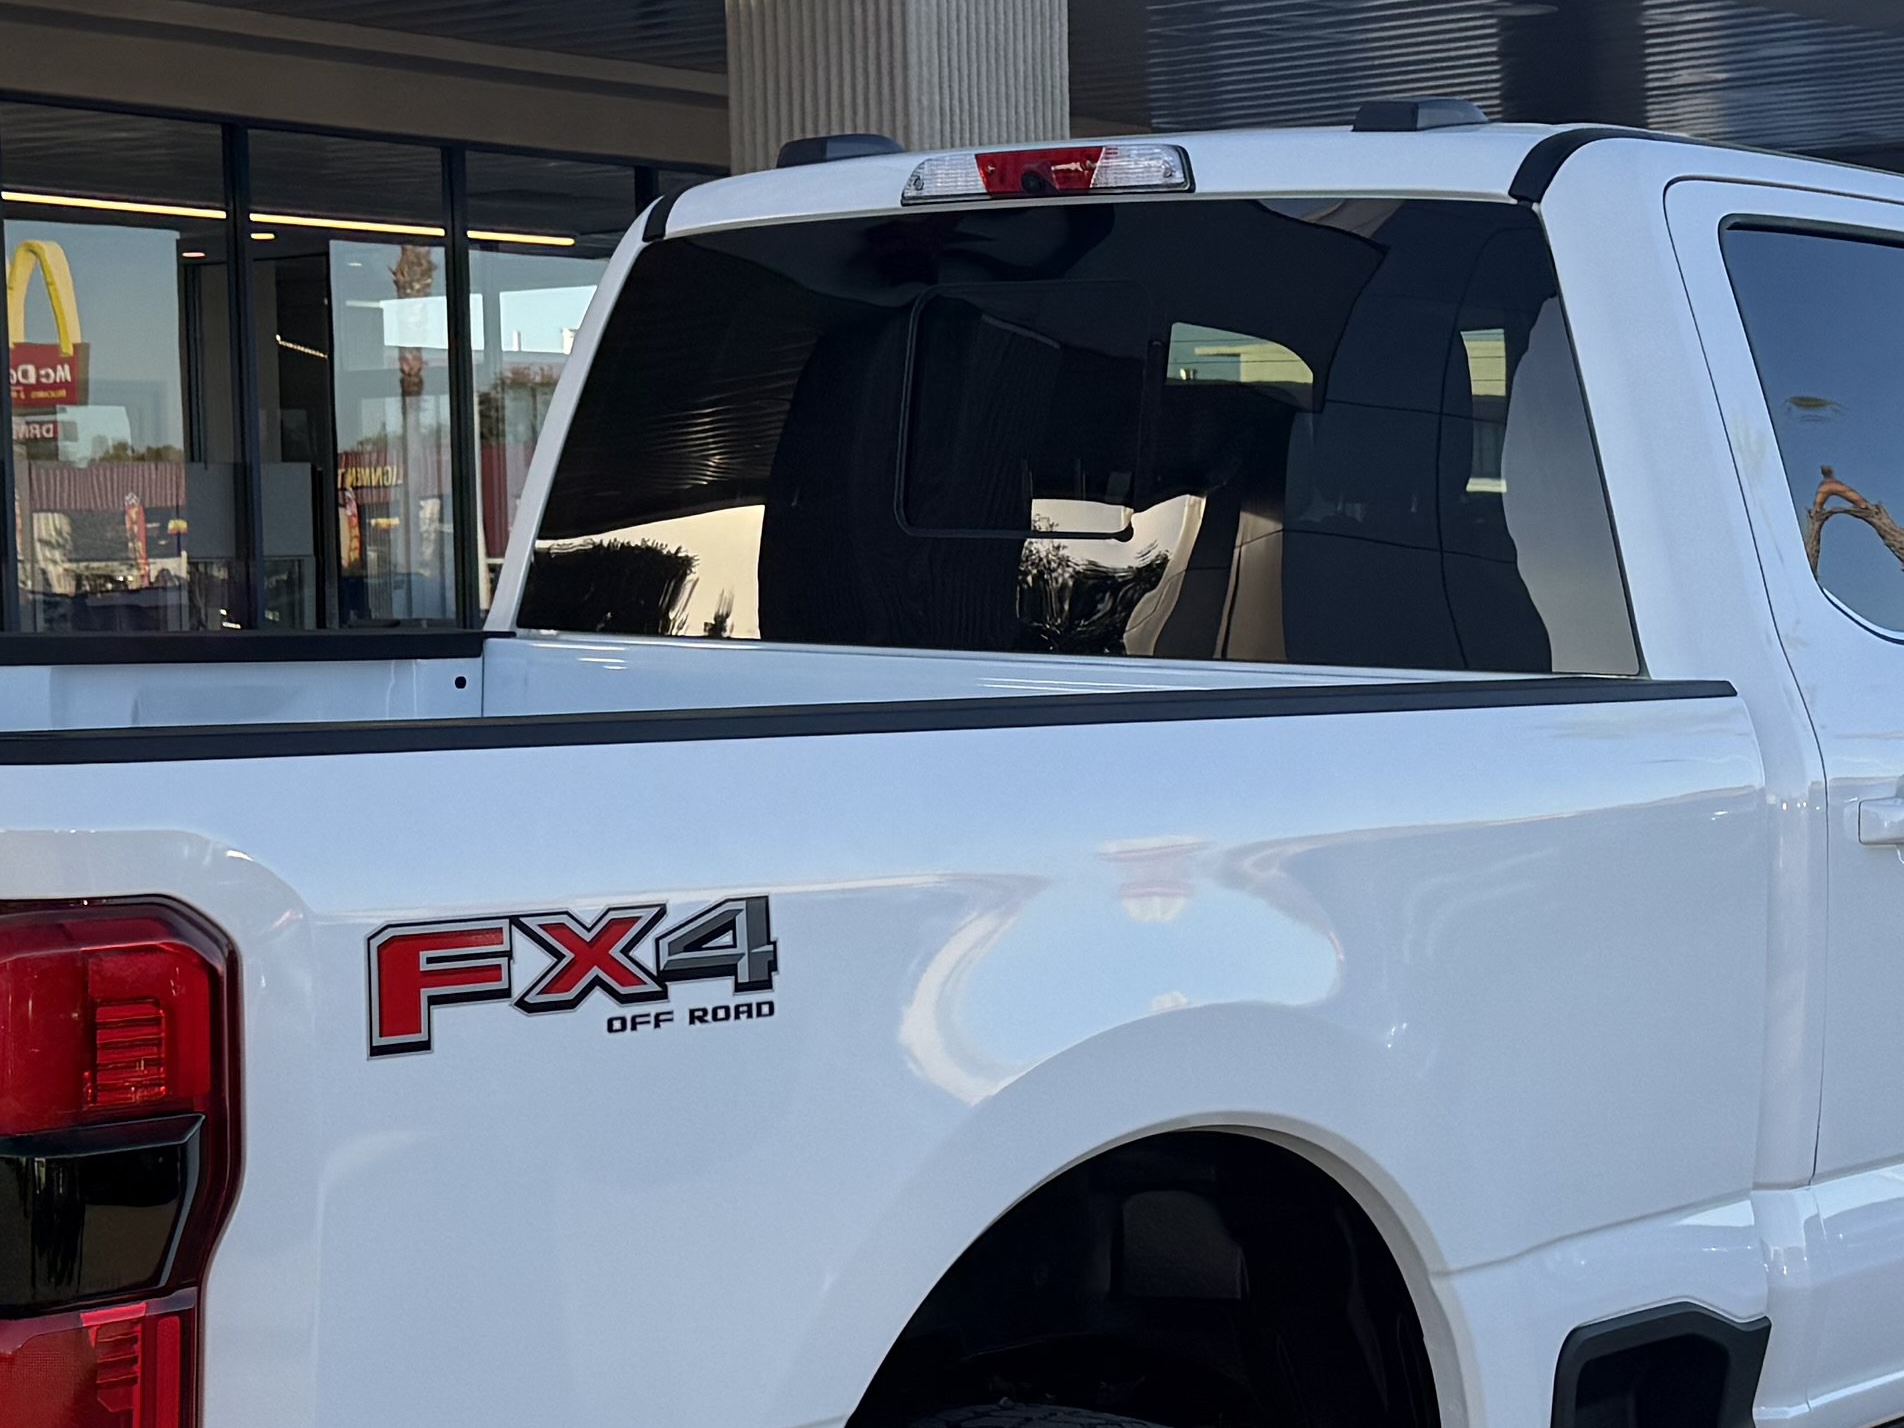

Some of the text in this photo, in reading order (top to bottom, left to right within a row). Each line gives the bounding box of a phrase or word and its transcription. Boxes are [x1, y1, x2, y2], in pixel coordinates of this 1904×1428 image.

[365, 894, 779, 1060] FX4
[606, 999, 776, 1033] OFF ROAD
